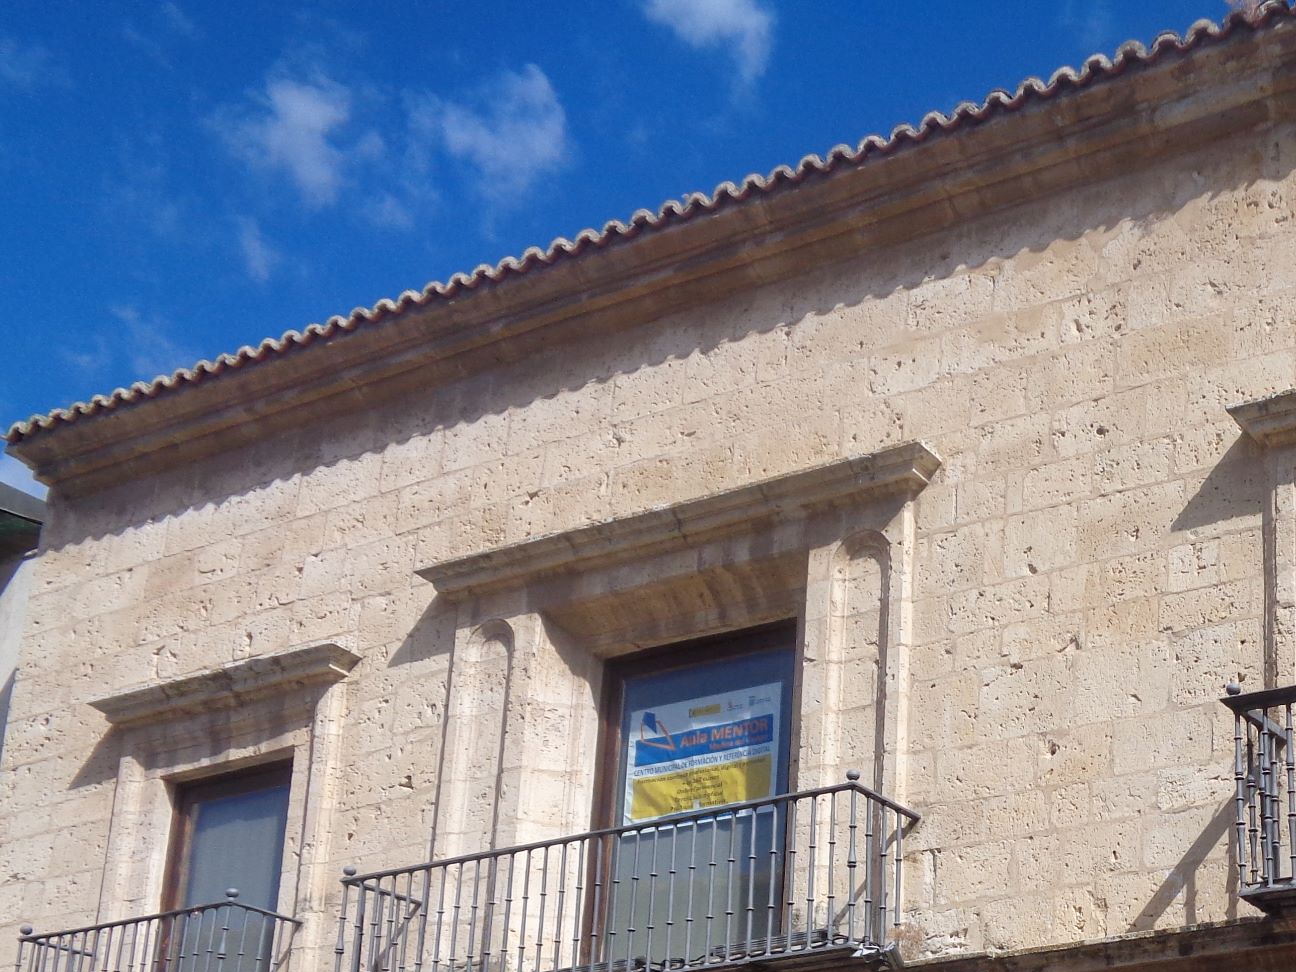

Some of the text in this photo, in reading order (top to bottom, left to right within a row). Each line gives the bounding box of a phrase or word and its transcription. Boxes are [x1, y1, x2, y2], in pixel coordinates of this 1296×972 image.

[681, 720, 769, 748] Aula MENTOR
[634, 768, 654, 776] CENTRO
[655, 762, 681, 773] MUNICIPAL
[681, 761, 689, 769] DE
[689, 754, 718, 767] FORMACIÓN
[724, 750, 751, 761] REFERENCIA
